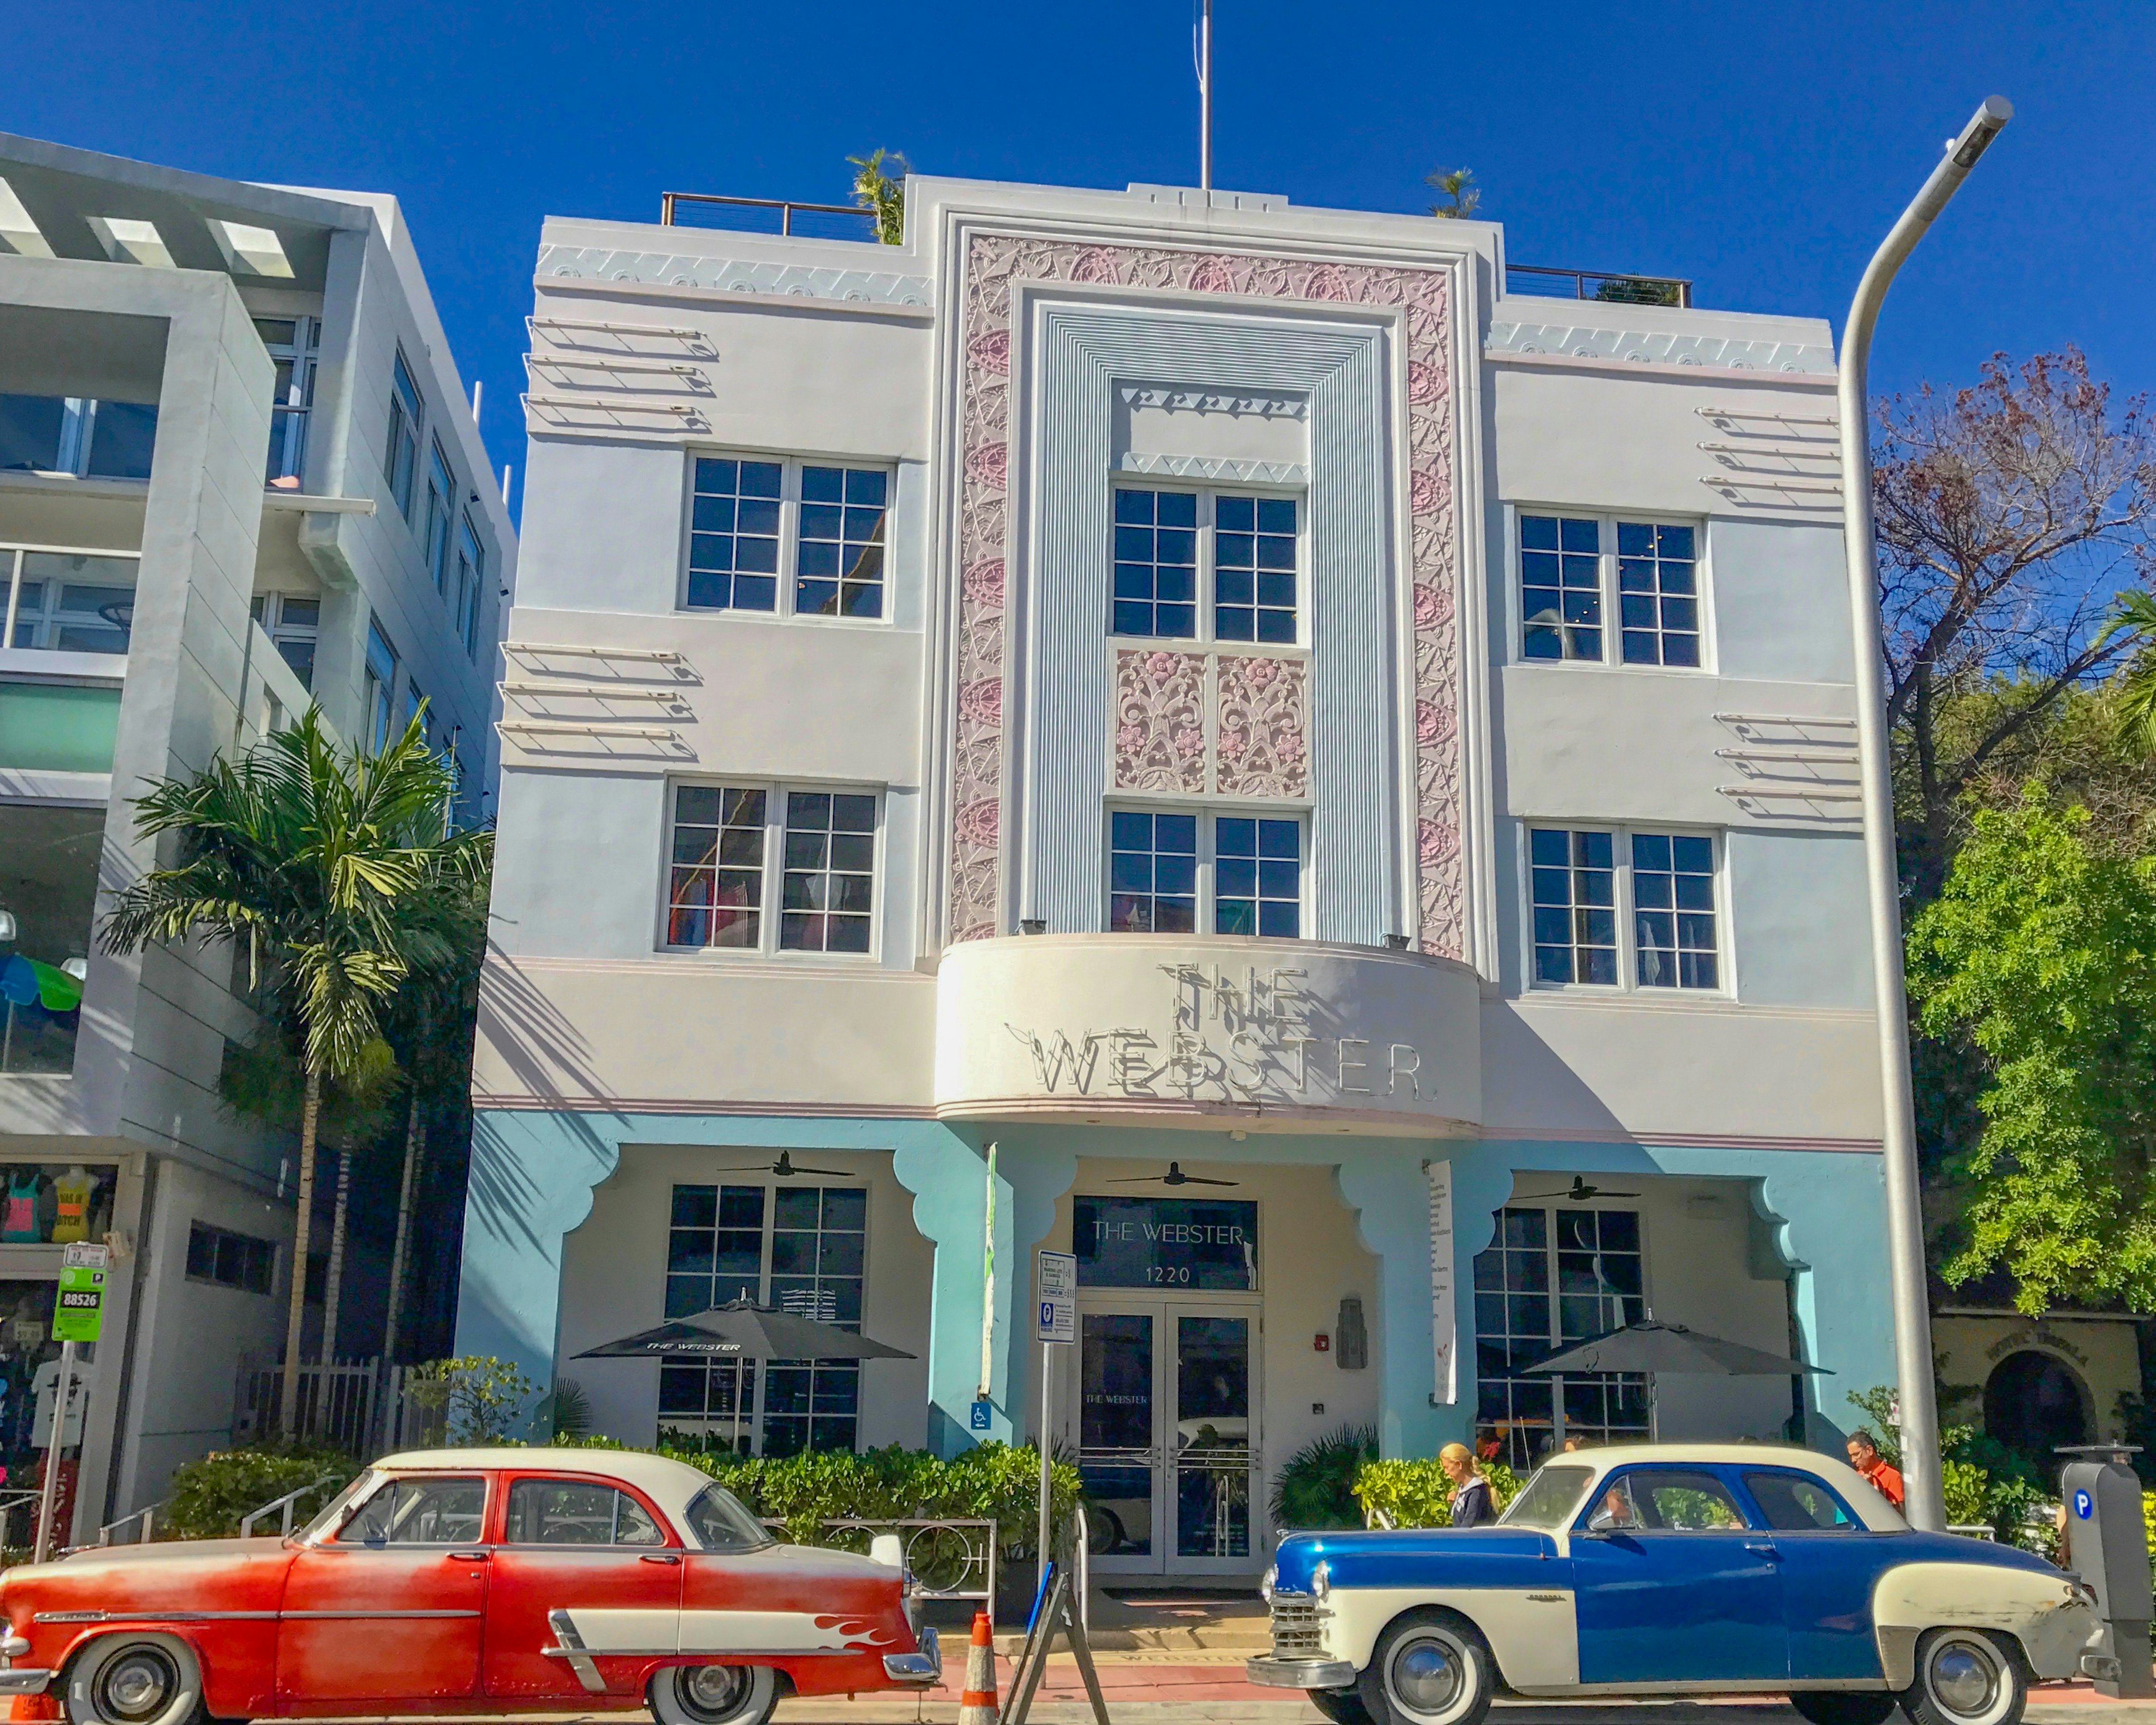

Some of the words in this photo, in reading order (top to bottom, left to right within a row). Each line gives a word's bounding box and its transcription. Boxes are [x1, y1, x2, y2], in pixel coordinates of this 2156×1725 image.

[1157, 962, 1306, 1024] THE
[1027, 1028, 1421, 1101] WEBSTER
[1092, 1221, 1134, 1241] THE
[1142, 1223, 1243, 1245] WEBSTER
[1146, 1267, 1190, 1283] 1220
[64, 1293, 97, 1307] 88526
[1106, 1395, 1147, 1404] WEBSTER
[2078, 1494, 2089, 1515] P
